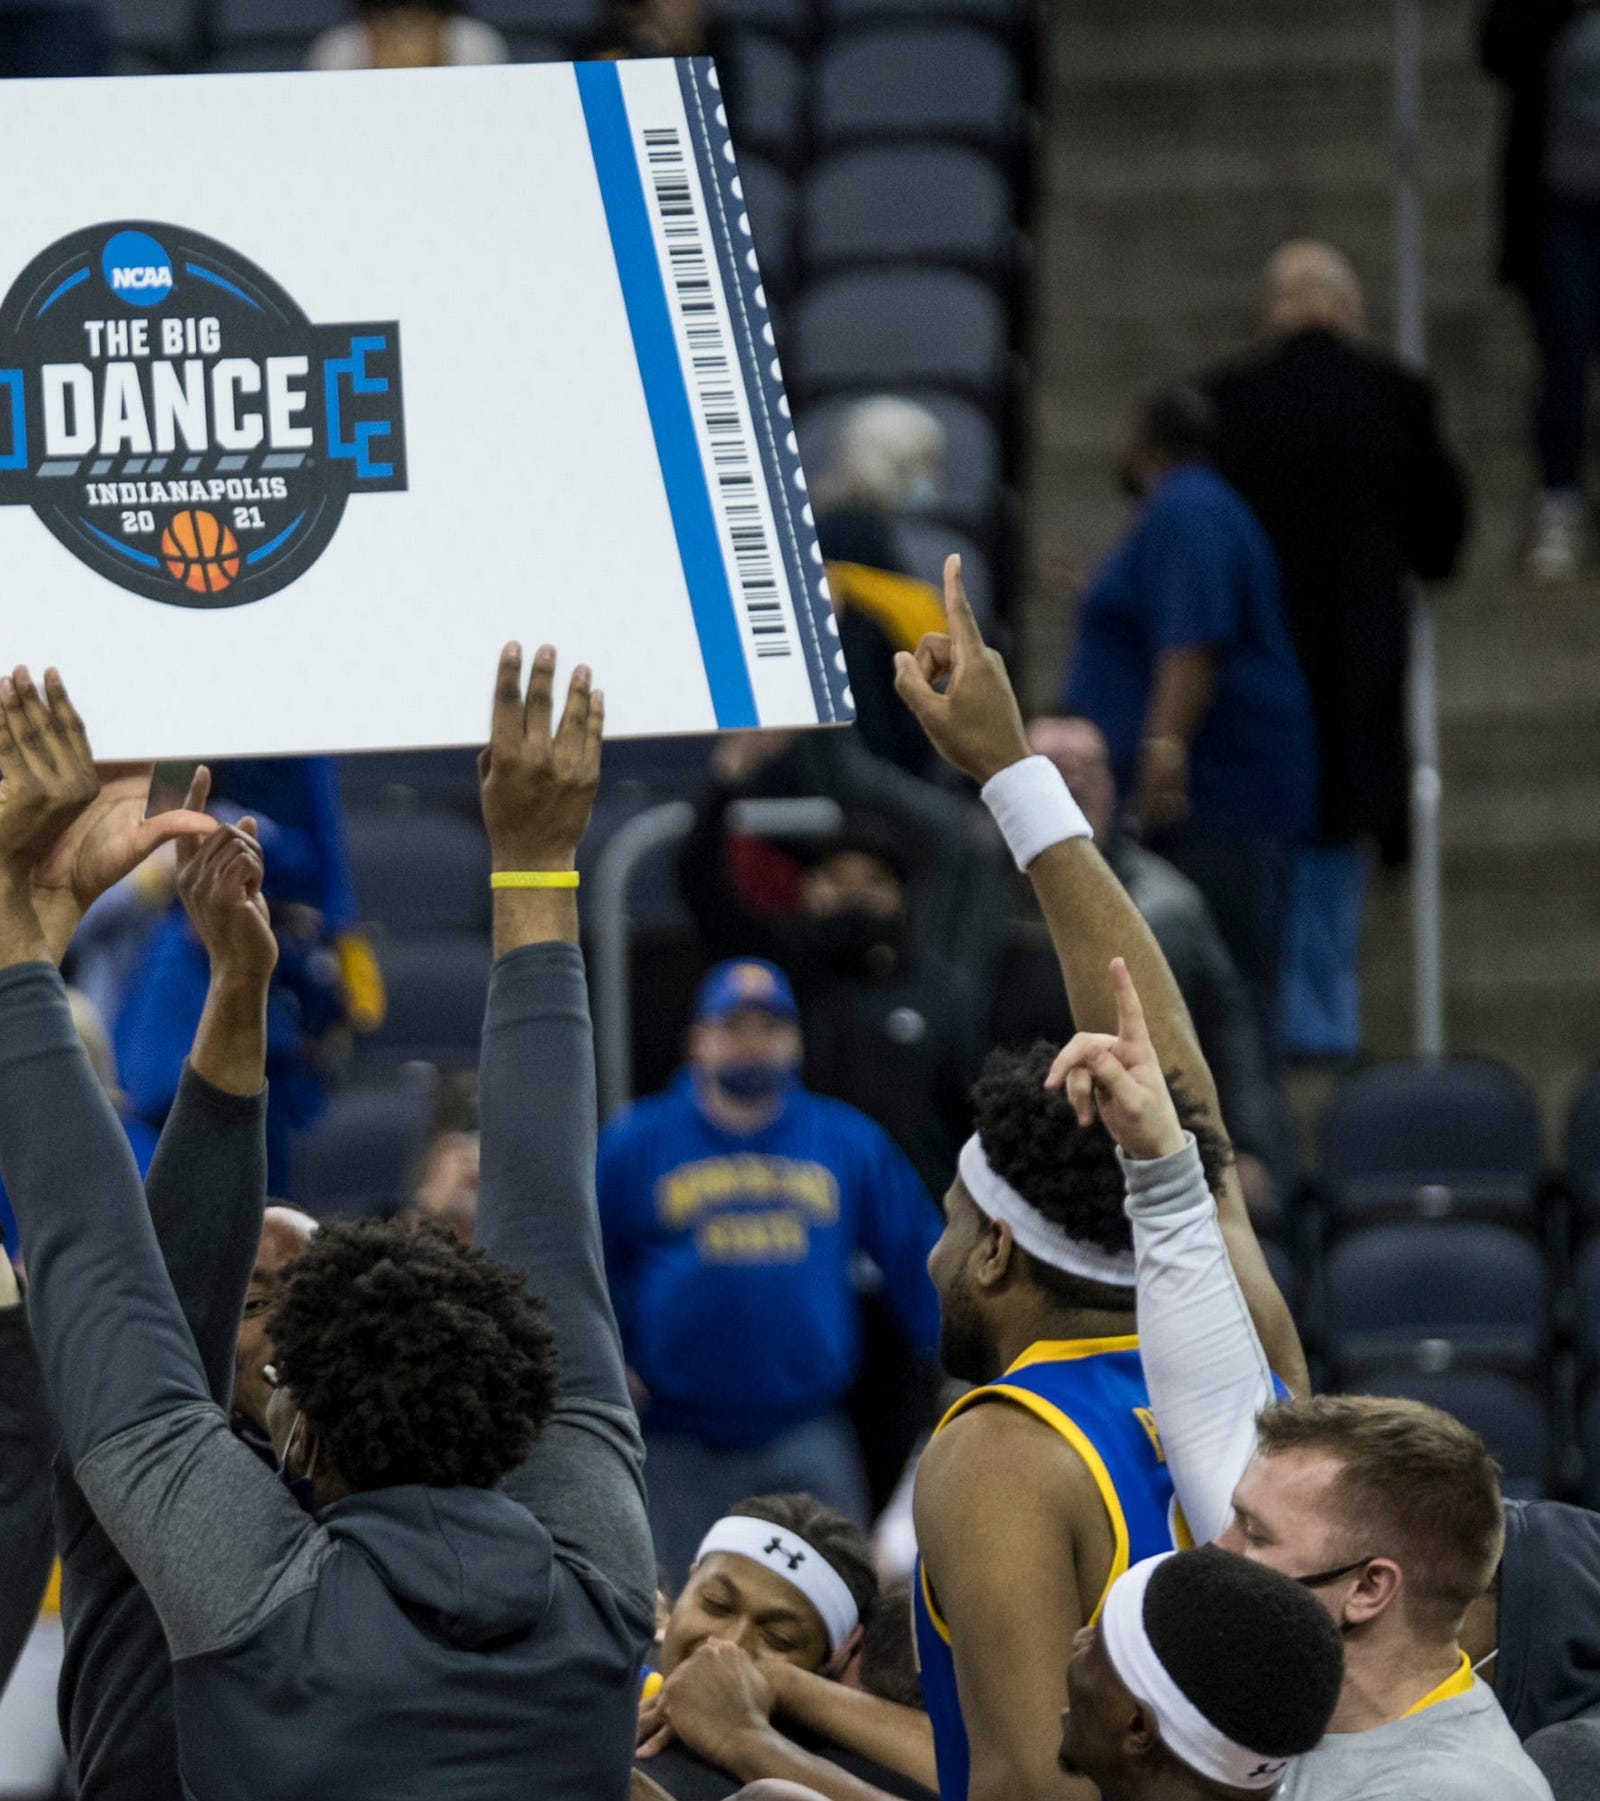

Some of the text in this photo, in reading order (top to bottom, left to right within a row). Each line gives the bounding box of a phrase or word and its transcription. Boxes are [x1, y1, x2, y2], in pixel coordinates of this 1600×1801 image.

[112, 266, 173, 289] NCAA
[84, 316, 222, 358] THE BIG
[42, 355, 314, 456] DANCE
[86, 476, 288, 506] INDIANAPOLIS
[121, 506, 266, 534] 20 21
